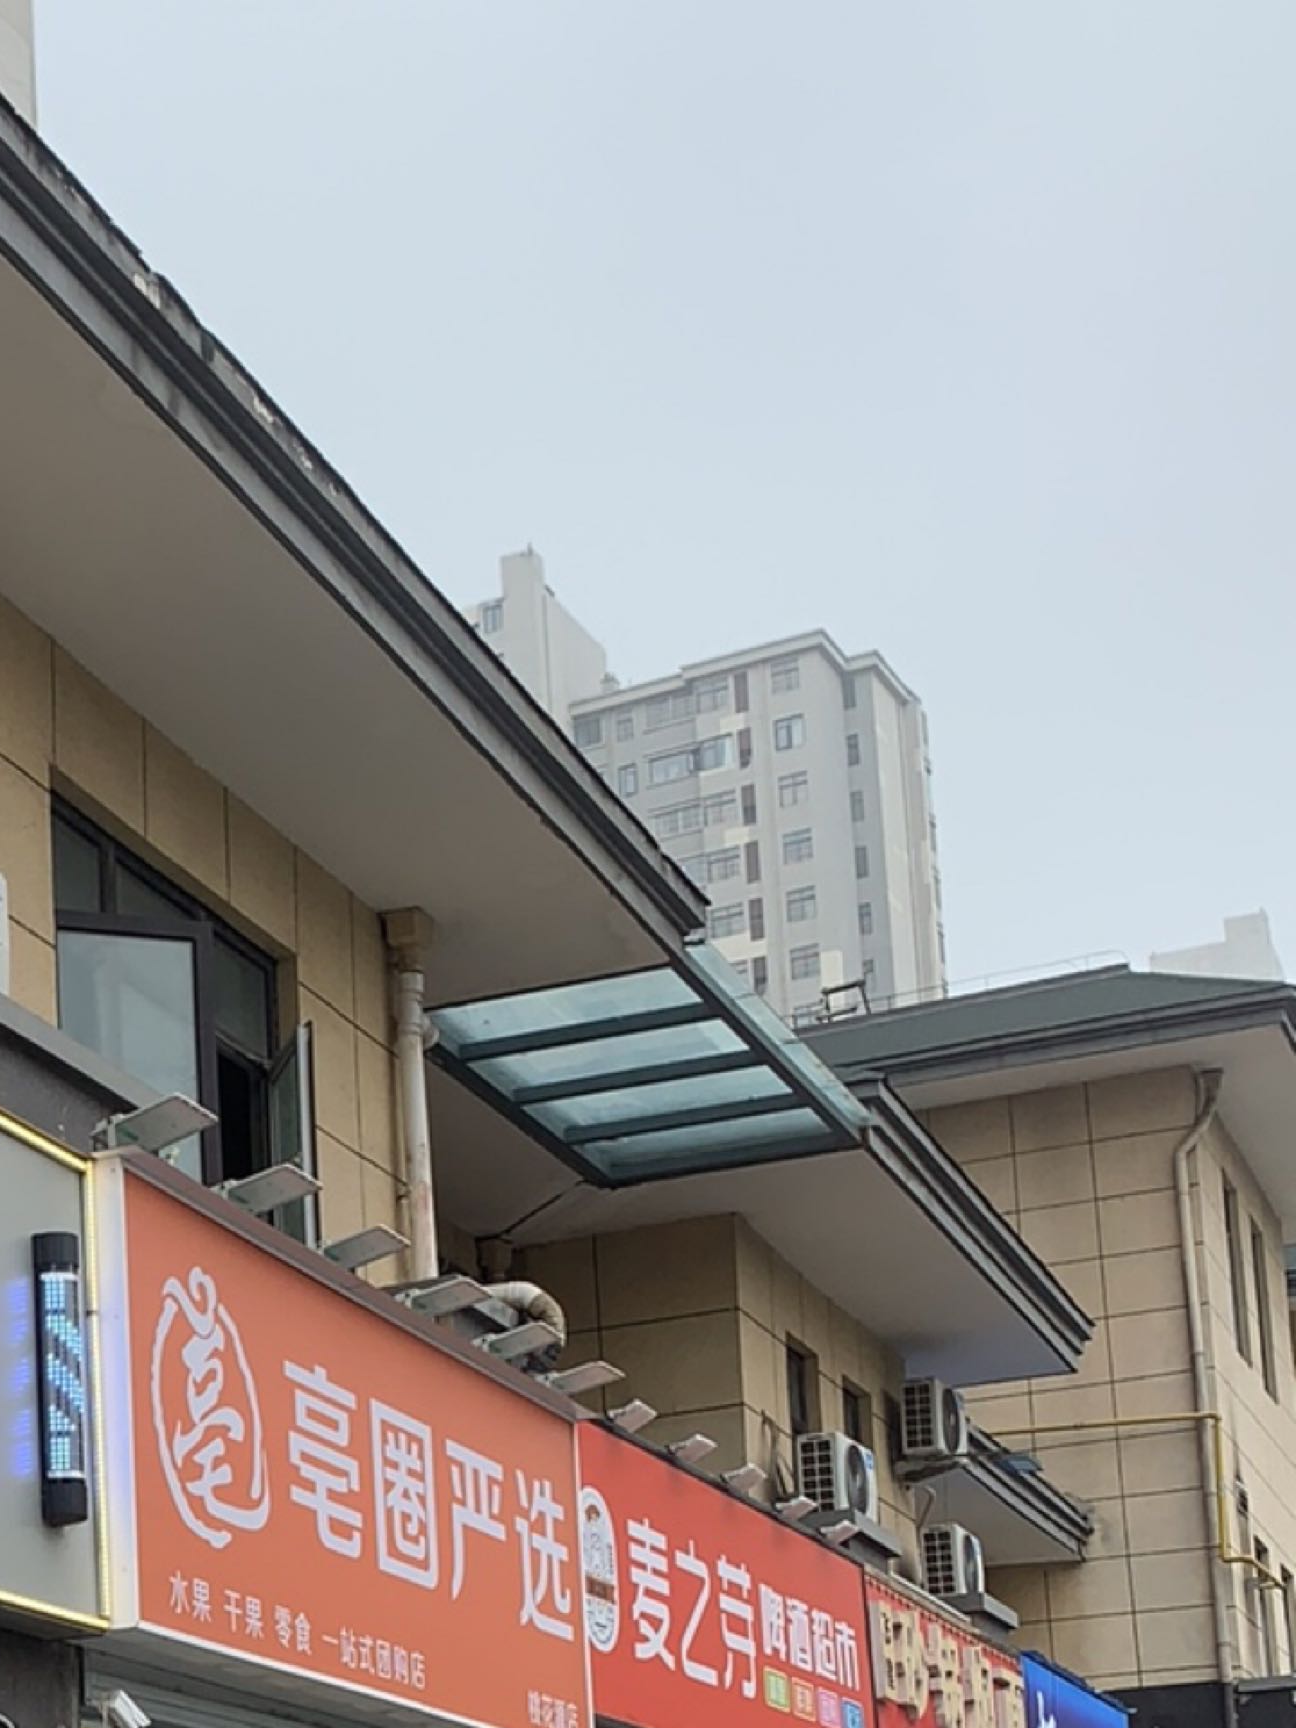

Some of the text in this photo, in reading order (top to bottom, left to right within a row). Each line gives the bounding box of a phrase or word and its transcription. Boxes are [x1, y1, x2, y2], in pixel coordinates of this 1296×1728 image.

[168, 1569, 212, 1623] 水果
[223, 1588, 264, 1640] 干果
[273, 1604, 312, 1656] 零食
